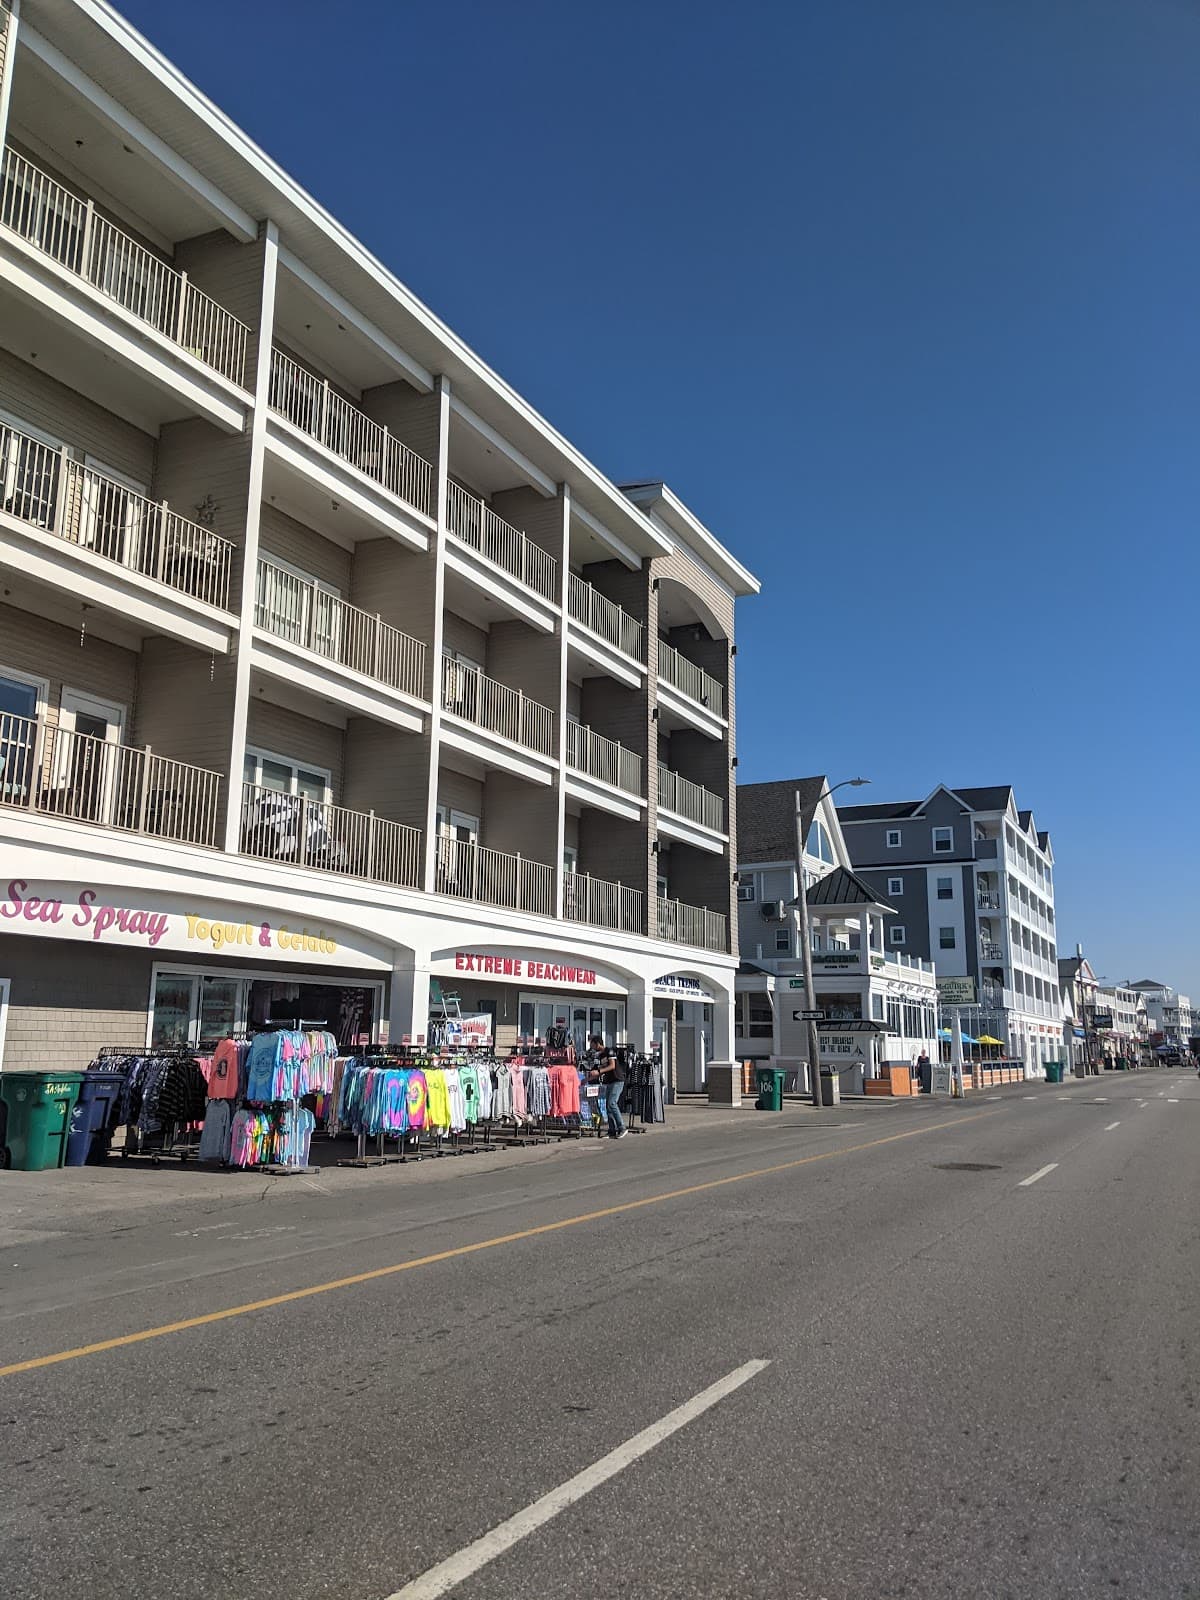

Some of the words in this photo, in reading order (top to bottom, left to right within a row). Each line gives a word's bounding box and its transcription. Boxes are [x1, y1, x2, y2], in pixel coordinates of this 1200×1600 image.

[0, 879, 63, 923] Sea
[72, 890, 169, 945] Spray
[185, 912, 253, 950] Yogurt
[259, 922, 271, 947] &
[278, 925, 337, 954] Gelato
[455, 952, 522, 977] EXTREME
[528, 961, 596, 985] BEACHWEAR
[677, 976, 700, 990] TRENDS
[760, 1081, 773, 1093] 106
